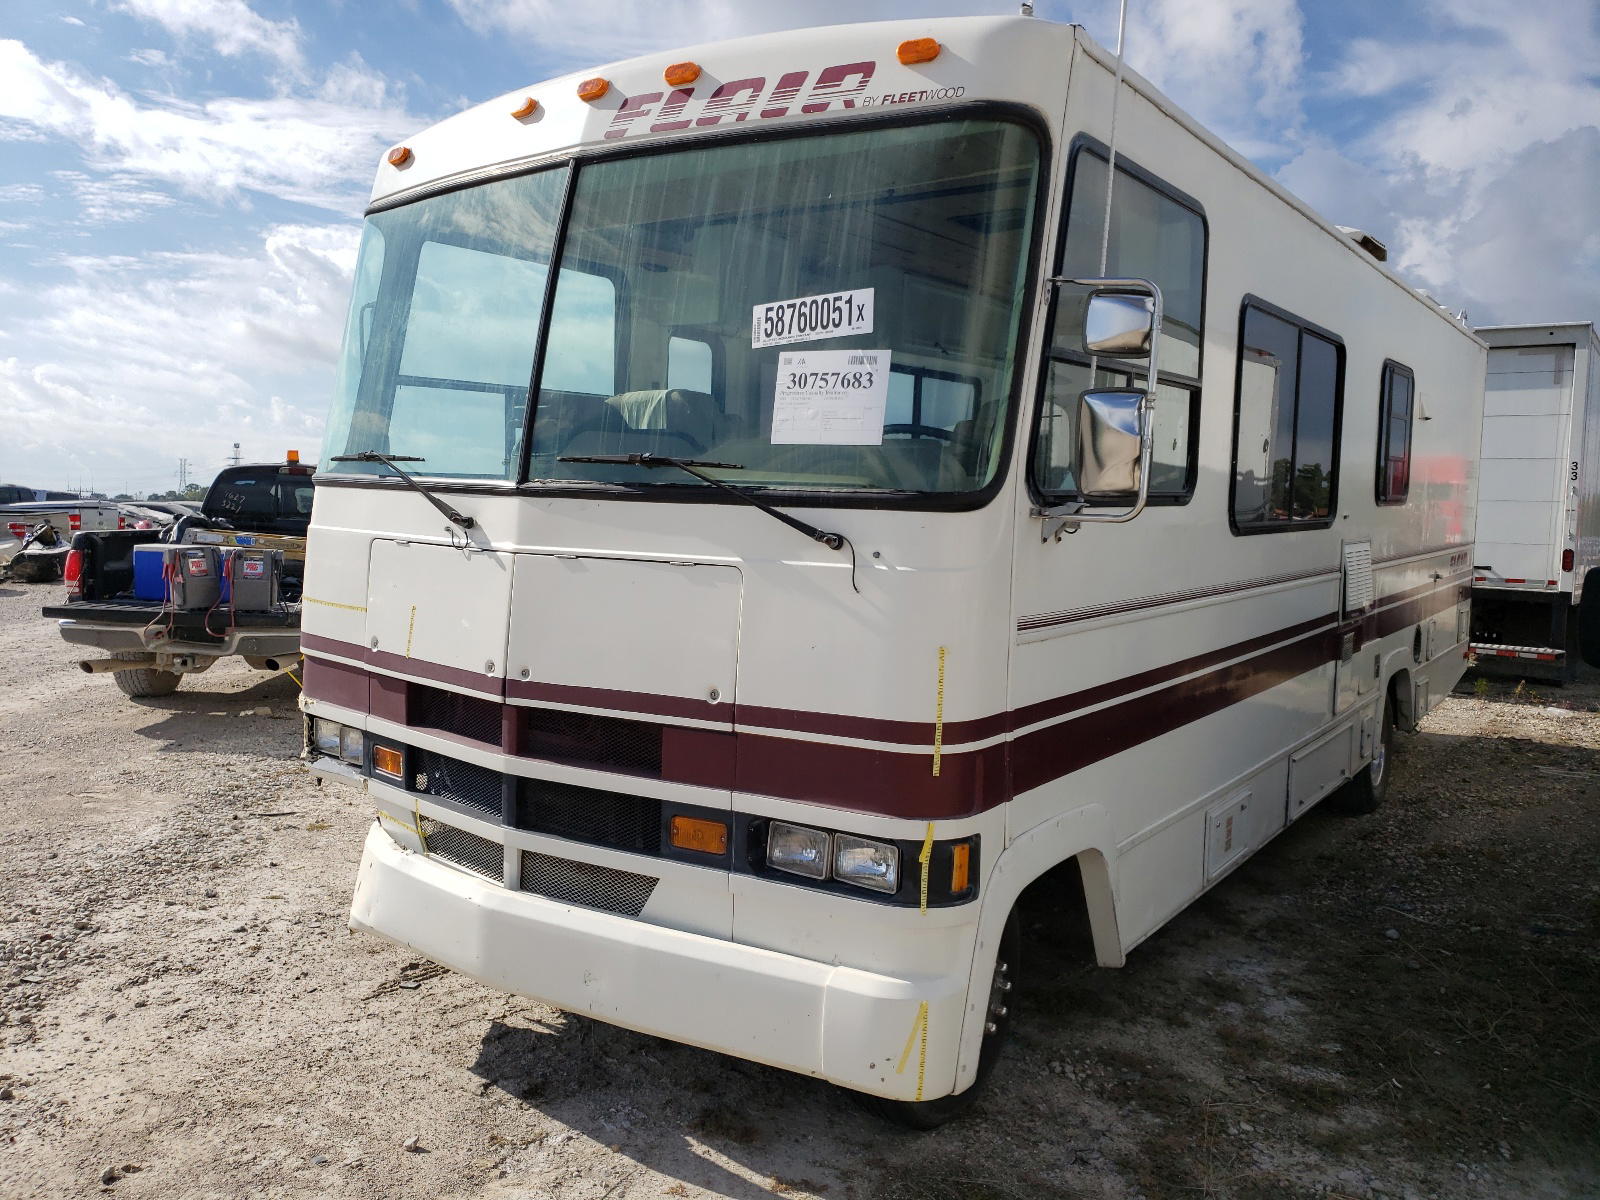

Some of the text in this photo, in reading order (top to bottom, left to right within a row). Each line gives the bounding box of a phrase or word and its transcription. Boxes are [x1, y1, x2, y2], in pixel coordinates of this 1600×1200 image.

[604, 60, 876, 139] FLAIR
[863, 86, 965, 107] BY FLEETWOOD
[764, 294, 853, 338] 58760051
[786, 371, 874, 390] 30757683
